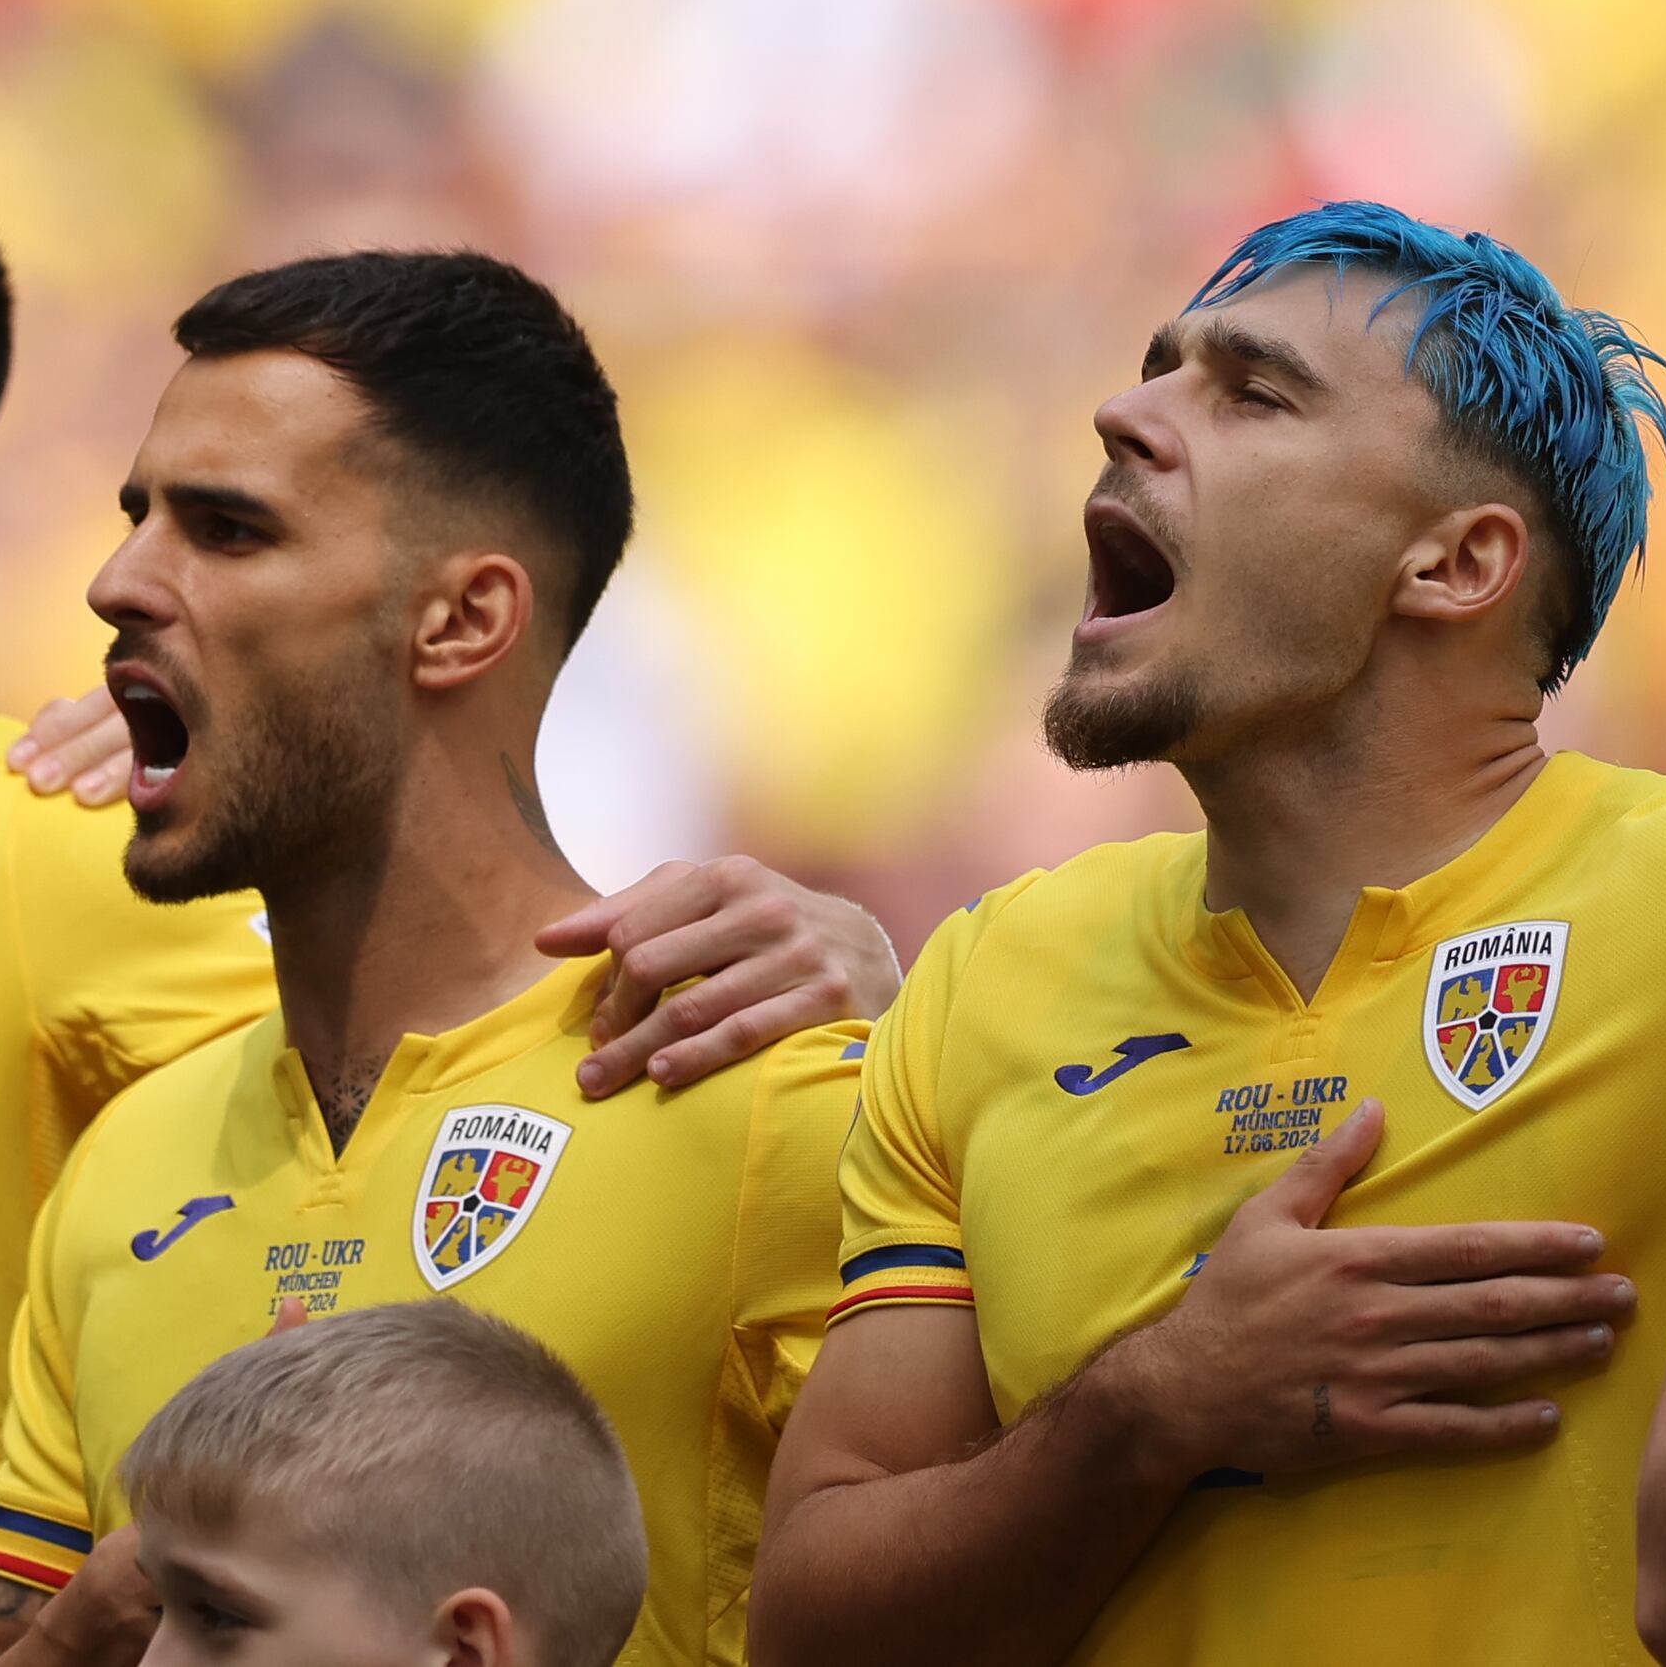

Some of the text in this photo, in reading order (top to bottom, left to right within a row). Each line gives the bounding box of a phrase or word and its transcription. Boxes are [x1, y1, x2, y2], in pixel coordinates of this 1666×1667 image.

[1444, 927, 1552, 971] ROMÂNIA
[1215, 1083, 1273, 1113] ROU
[1292, 1075, 1347, 1106] UKR
[448, 1112, 554, 1154] ROMÂNIA
[1231, 1107, 1322, 1132] MÜNCHEN
[1223, 1127, 1321, 1154] 17.06.2024
[264, 1241, 312, 1271] ROU
[321, 1238, 366, 1266] UKR
[275, 1270, 343, 1294] MÜNCHEN
